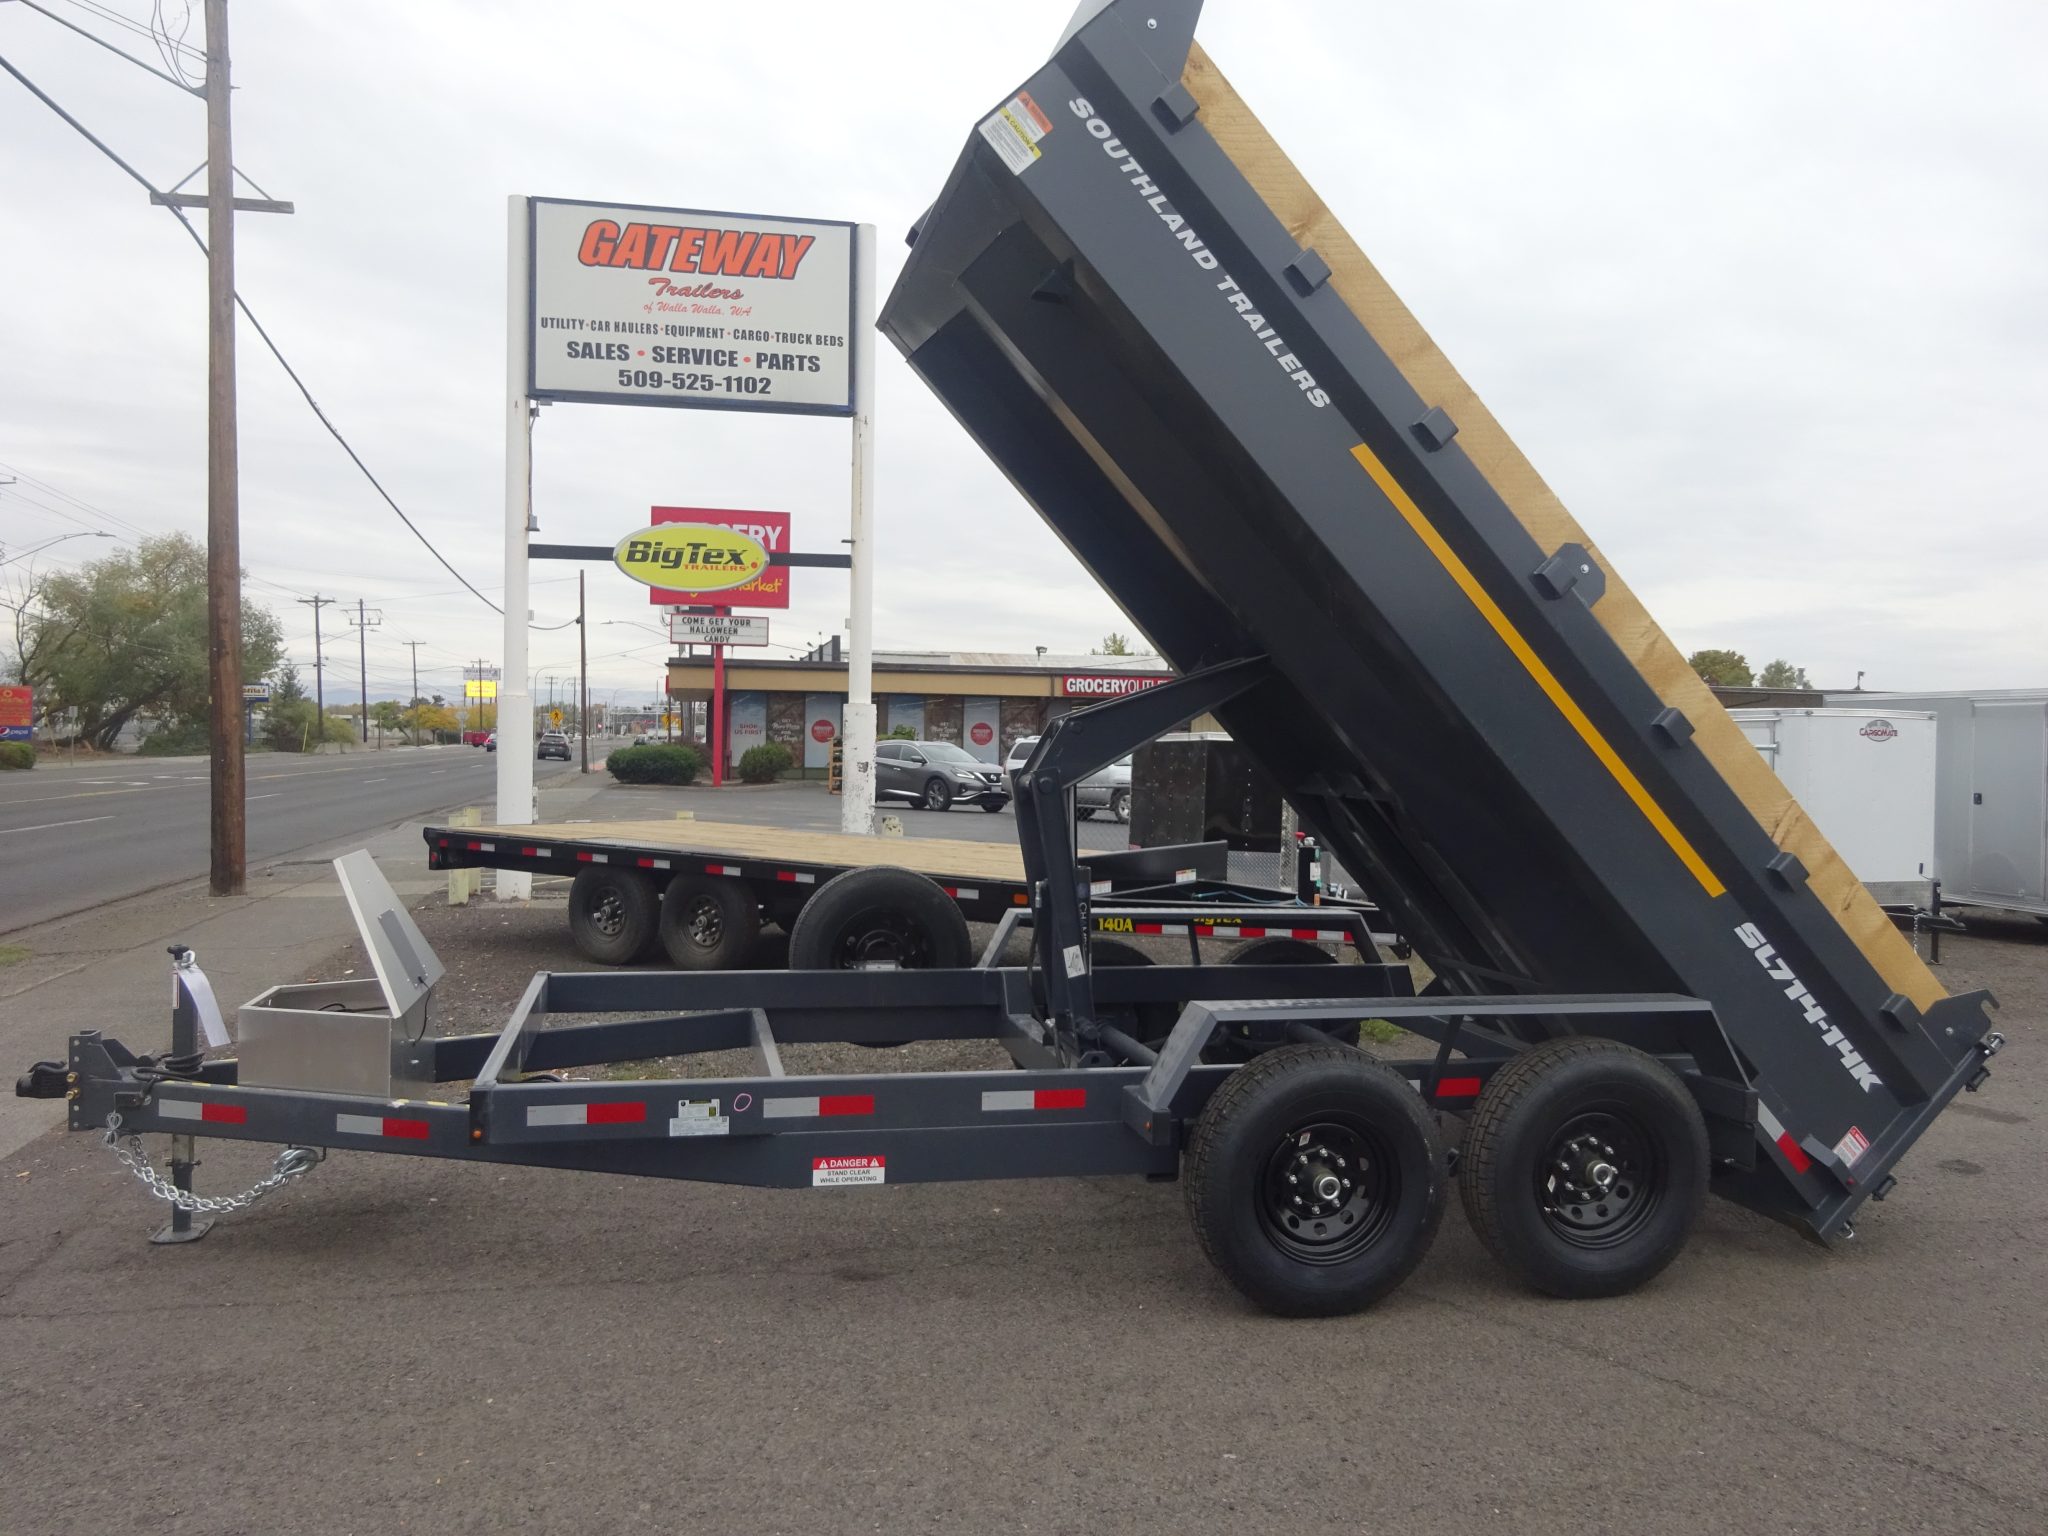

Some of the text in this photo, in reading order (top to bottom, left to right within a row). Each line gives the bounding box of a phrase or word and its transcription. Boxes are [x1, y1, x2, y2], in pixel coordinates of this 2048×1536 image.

[578, 219, 816, 280] GATEWAY
[1069, 97, 1330, 408] SOUTHLAND TRAILERS
[648, 277, 744, 300] Trailers
[643, 302, 653, 314] of
[657, 302, 689, 313] Walla
[730, 305, 752, 316] WA
[541, 317, 844, 348] UTILITY CAR HAULERS EQUIPMENT CARGO TRUCK BEDS
[567, 341, 821, 372] SALES SERVICE PARTS
[618, 369, 771, 395] 509-525-1102
[626, 541, 748, 569] BigTex
[683, 563, 747, 572] TRAILERS
[682, 616, 751, 627] COME GET YOUR
[690, 626, 739, 635] HALLOWEEN
[704, 635, 731, 644] CANDY
[1098, 917, 1134, 932] 140A
[1734, 922, 1884, 1094] SL714-14K
[830, 1158, 868, 1168] DANGER
[841, 1175, 877, 1183] OPERATING
